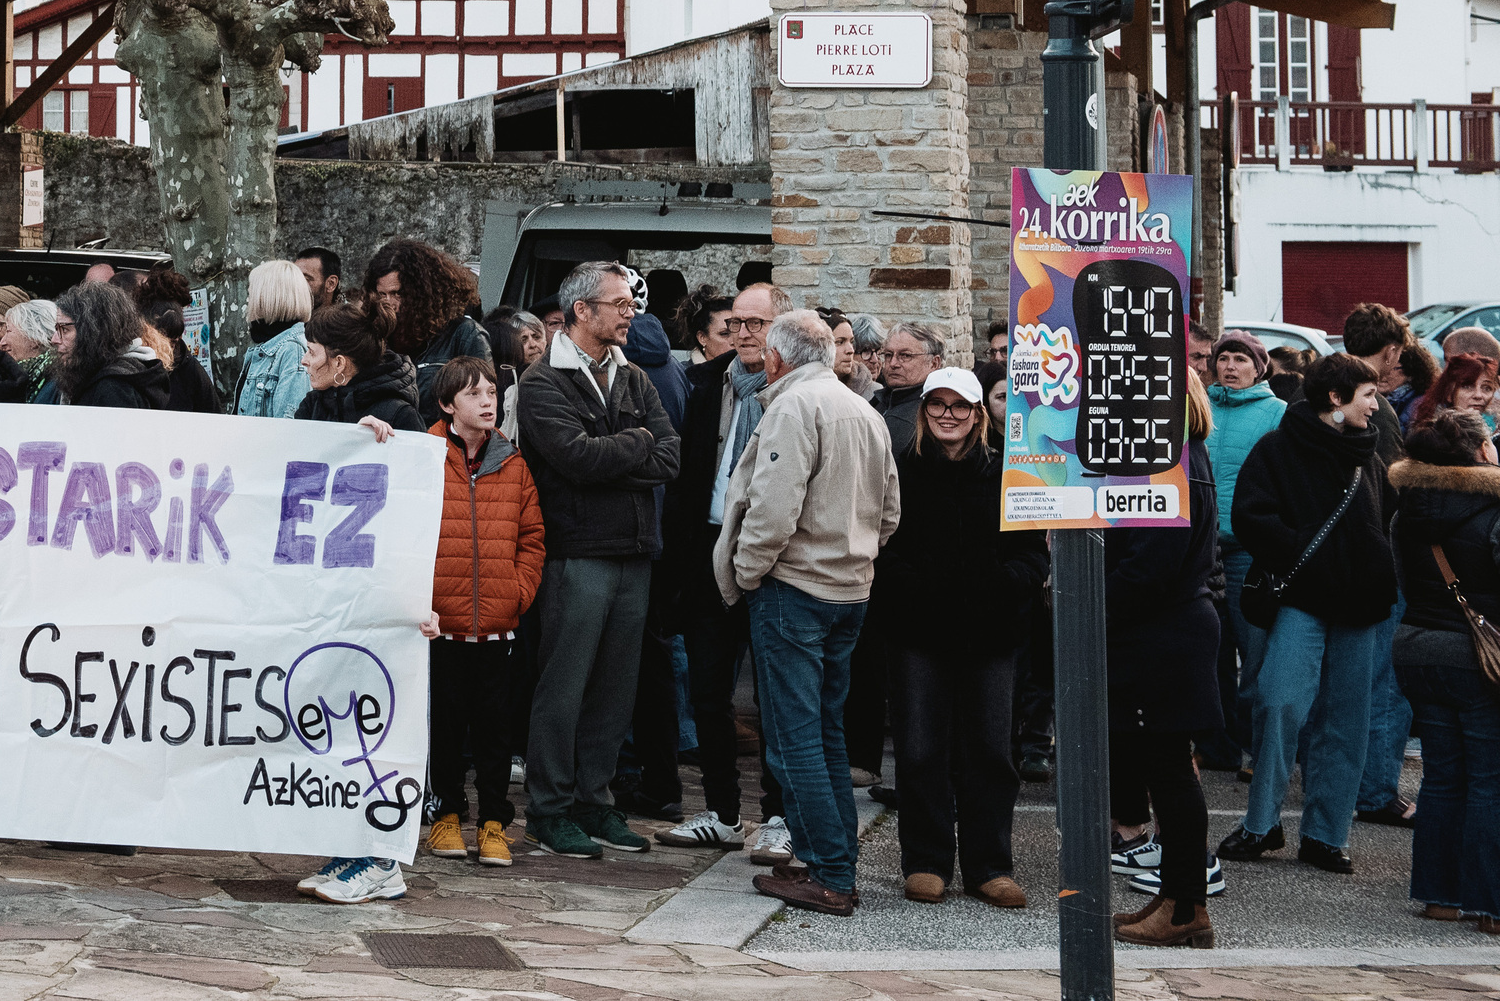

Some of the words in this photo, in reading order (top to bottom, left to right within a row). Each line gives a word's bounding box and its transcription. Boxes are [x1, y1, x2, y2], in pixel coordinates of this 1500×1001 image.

[834, 24, 874, 36] PLACE
[831, 64, 875, 76] PLAZA
[1063, 176, 1100, 207] aek
[1050, 243, 1072, 252] Bilbora
[1099, 243, 1136, 254] martxoaren
[1138, 245, 1154, 254] 19tik
[1155, 246, 1173, 255] 29ra
[1088, 274, 1098, 282] KM
[1088, 343, 1110, 352] ORDUA
[1110, 344, 1136, 352] TENOREA
[1012, 358, 1040, 370] Euskara
[1014, 372, 1040, 391] gara
[1088, 354, 1172, 400] 02:53
[1088, 406, 1109, 415] EGUNA
[1106, 489, 1167, 512] berria
[273, 460, 390, 569] EZ
